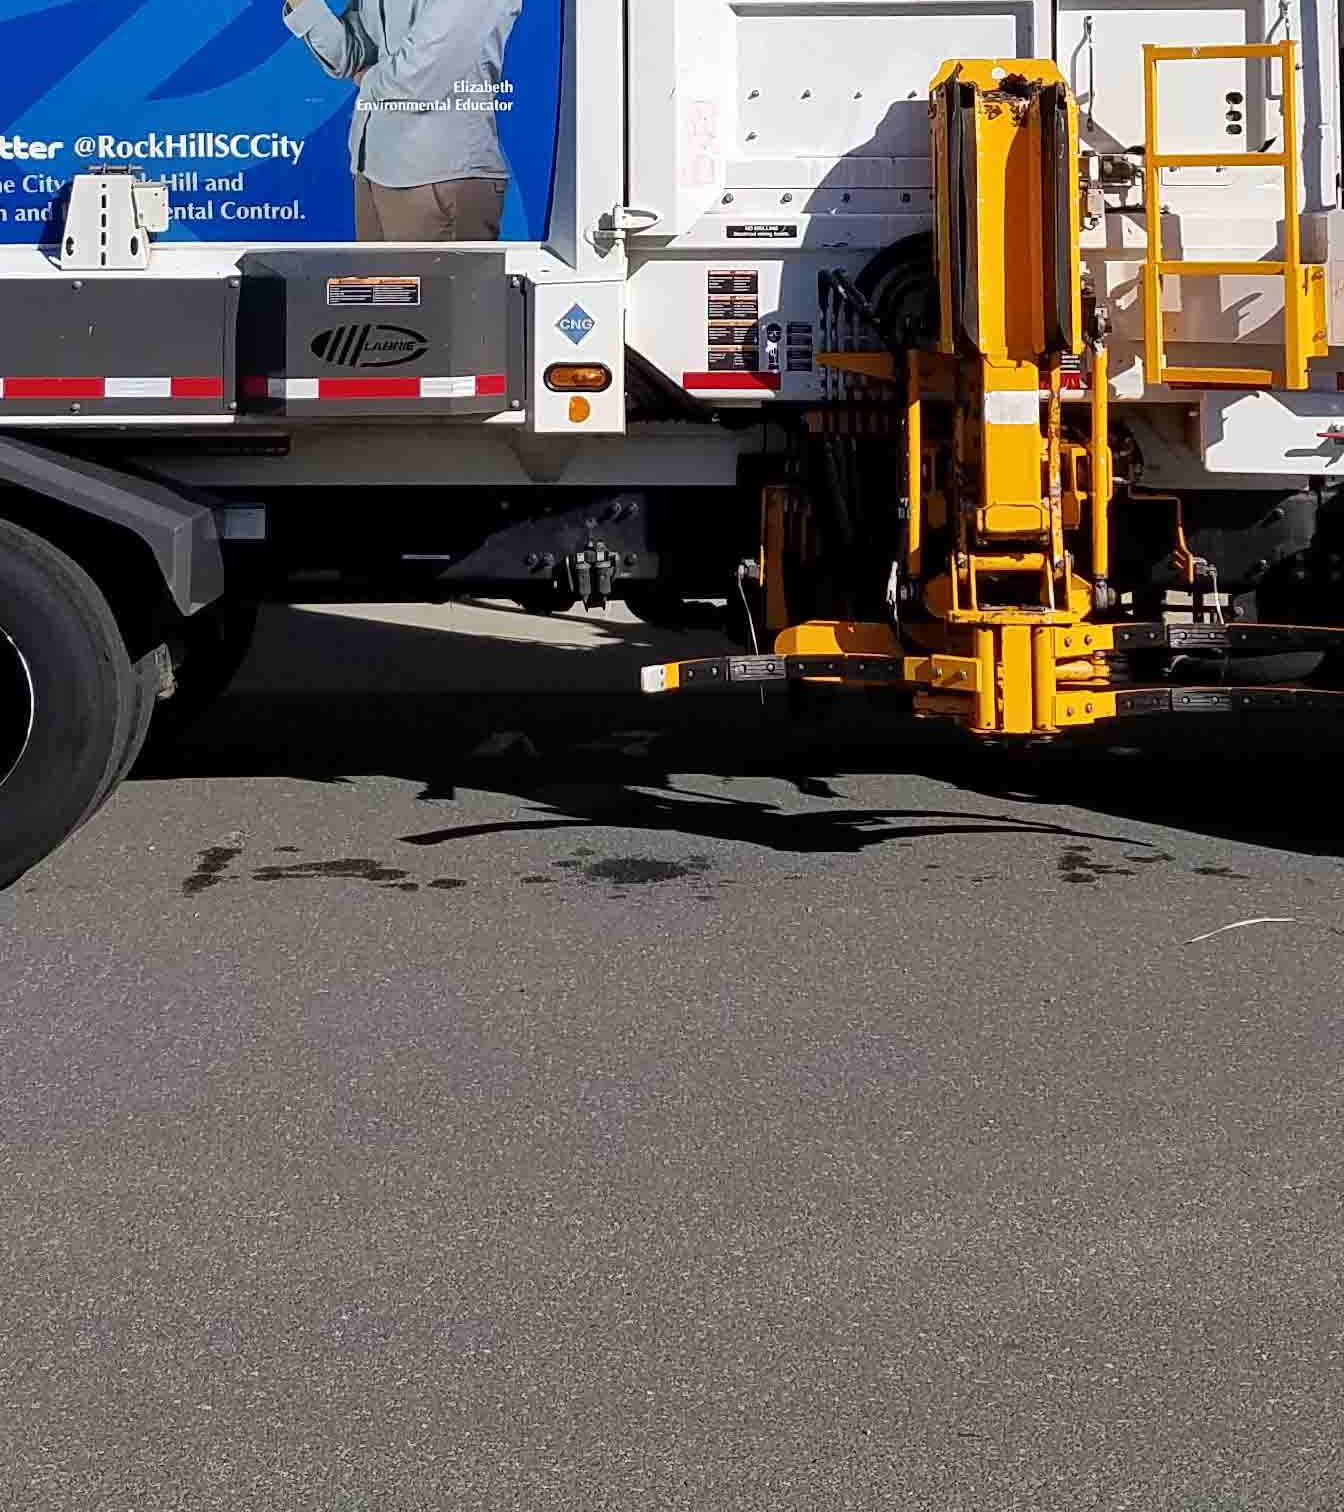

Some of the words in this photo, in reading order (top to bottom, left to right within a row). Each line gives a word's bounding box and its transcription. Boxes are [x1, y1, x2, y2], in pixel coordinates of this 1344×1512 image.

[453, 80, 514, 93] Elizabeth
[356, 98, 451, 111] Environmental
[455, 98, 513, 111] Educator
[74, 133, 306, 165] @RockHillSCCity
[22, 174, 65, 198] City
[159, 173, 198, 193] Hill
[205, 172, 244, 193] and
[15, 200, 53, 222] and
[220, 199, 306, 220] Control.
[559, 317, 594, 330] CNG
